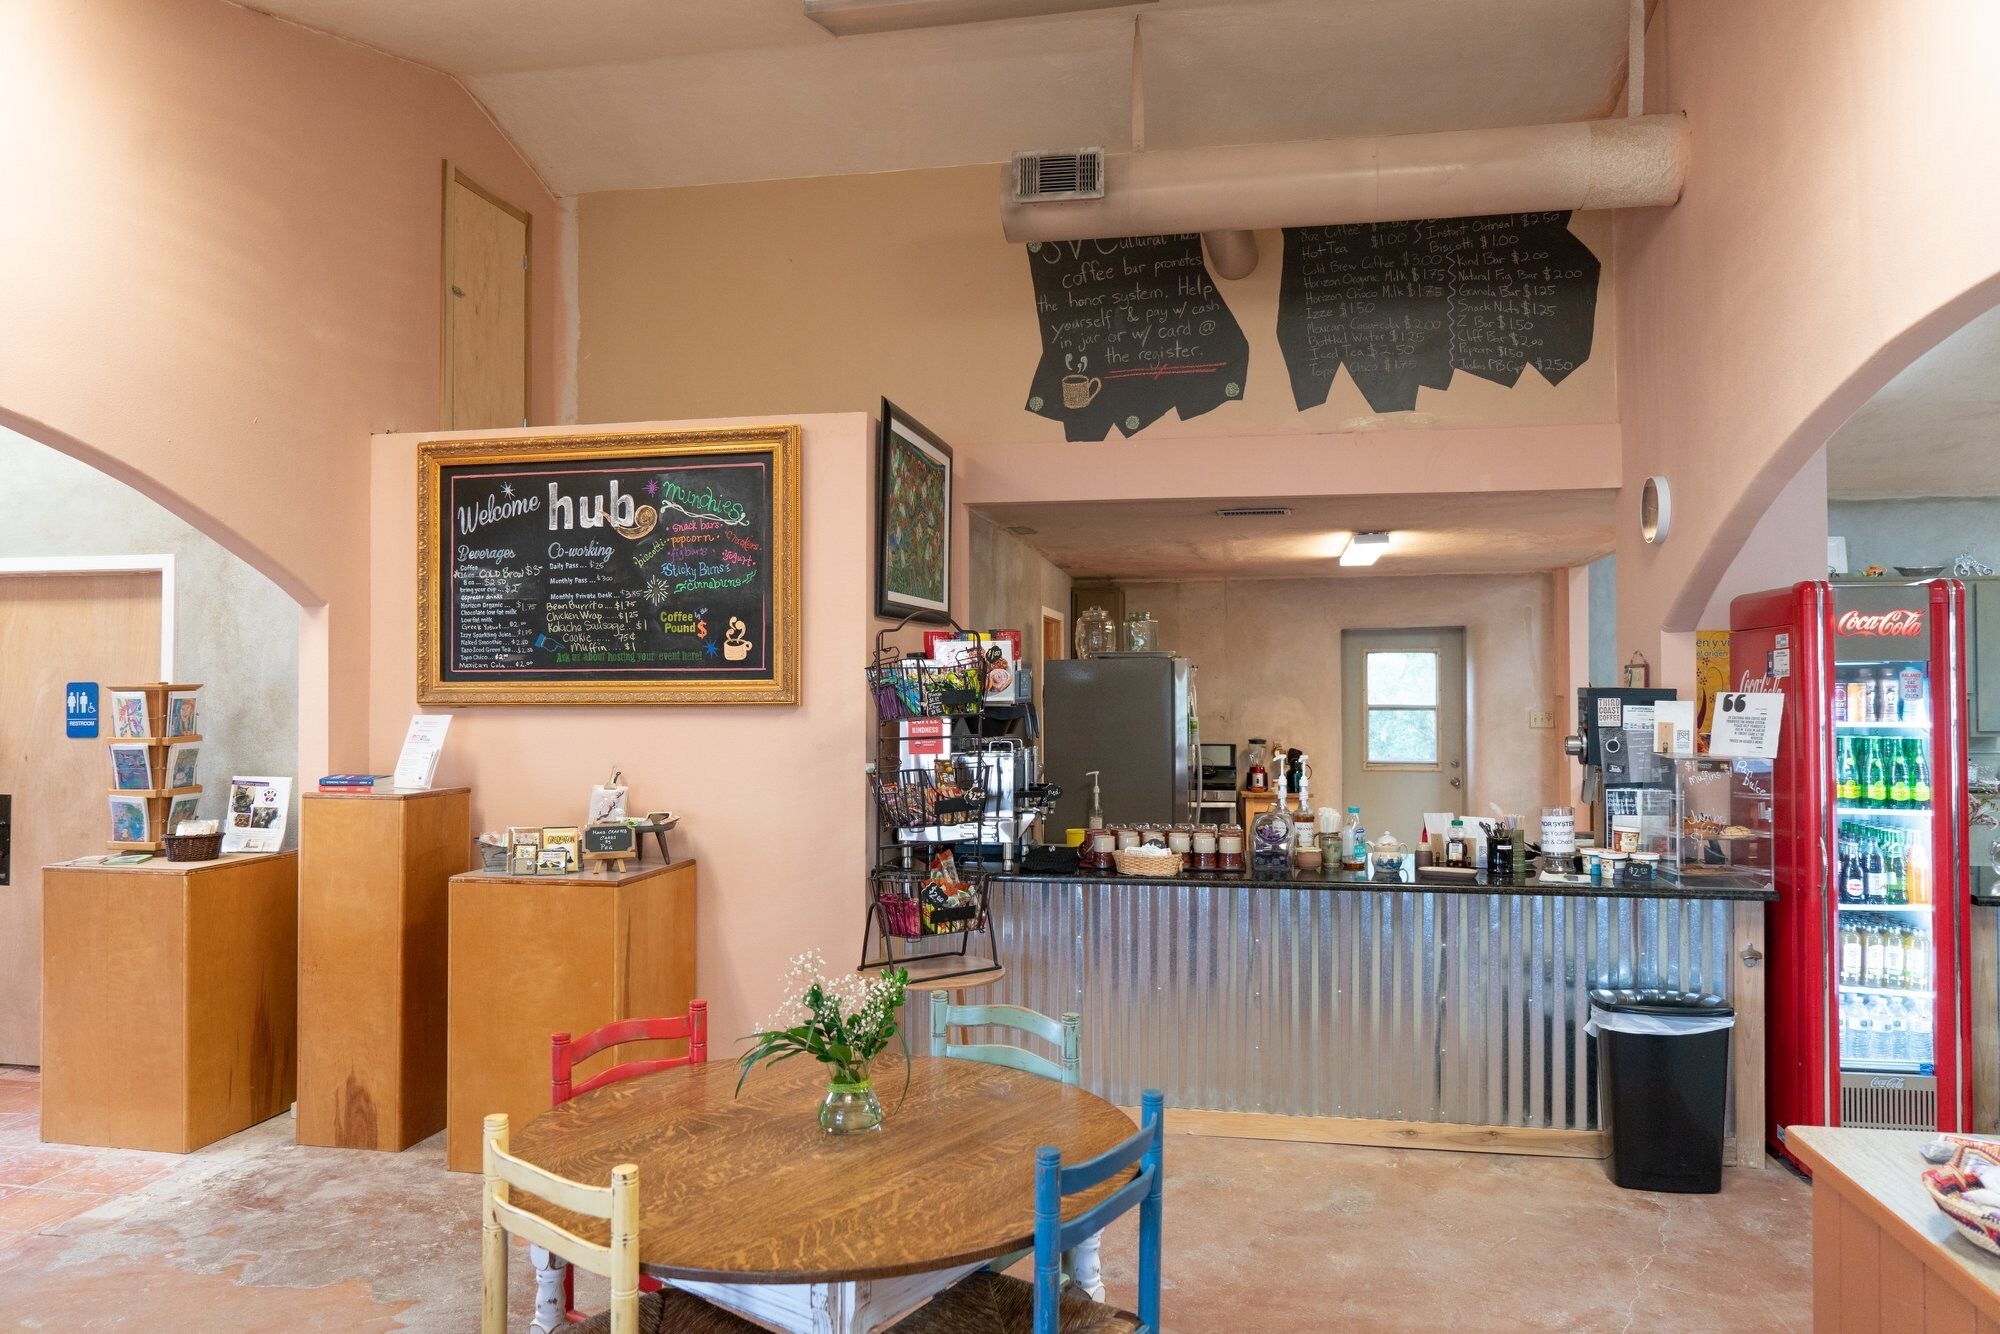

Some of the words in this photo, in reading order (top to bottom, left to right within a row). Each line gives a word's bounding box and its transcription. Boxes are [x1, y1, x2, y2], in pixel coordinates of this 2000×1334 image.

[1426, 223, 1468, 240] Instant
[1472, 214, 1514, 232] Oatmeal
[1302, 244, 1325, 260] Hot
[1325, 241, 1348, 254] Tea
[1371, 233, 1408, 248] $1.00
[1430, 237, 1474, 253] Biscotti
[1479, 235, 1520, 249] $1.00
[1303, 262, 1325, 276] Cold
[1330, 260, 1357, 272] Brew
[1362, 255, 1395, 270] Coffee
[1457, 254, 1480, 267] Kind
[1483, 252, 1505, 265] Bar
[1062, 260, 1114, 288] coffee
[1123, 256, 1146, 276] bar
[1154, 250, 1203, 276] promotes
[1304, 277, 1341, 289] Horizon
[1458, 269, 1491, 281] Natural
[1495, 268, 1513, 286] Fig
[1517, 269, 1538, 280] Bar
[1037, 295, 1058, 313] the
[1069, 291, 1106, 308] honor
[1112, 282, 1169, 309] system.
[1178, 275, 1213, 299] Help
[1347, 288, 1378, 299] Choco
[1458, 284, 1497, 296] Granola
[1499, 285, 1520, 298] Bar
[1305, 307, 1334, 319] Izze
[1458, 299, 1491, 313] Snack
[1494, 301, 1520, 314] Nuts
[1052, 308, 1112, 344] yourself
[1127, 306, 1139, 322] &
[1146, 308, 1168, 323] pay
[1173, 302, 1187, 318] w/
[1192, 302, 1220, 314] cash
[1456, 315, 1467, 327] Z
[1474, 315, 1495, 328] Bar
[1060, 336, 1072, 349] in
[1078, 333, 1101, 352] jar
[1108, 331, 1126, 343] or
[1132, 324, 1152, 347] w/
[1158, 320, 1191, 339] card
[1199, 320, 1216, 336] @
[1353, 331, 1384, 342] Water
[1104, 346, 1129, 363] the
[1138, 340, 1204, 369] register.
[1308, 347, 1338, 360] Iced
[1344, 344, 1364, 357] Tea
[548, 480, 635, 531] hub
[663, 481, 744, 521] Munchies
[457, 493, 541, 536] Welcome
[672, 523, 697, 532] snack
[701, 520, 720, 529] bars
[670, 534, 714, 547] popcorn
[457, 544, 516, 565] Beverages
[548, 539, 615, 562] Co-working
[633, 539, 665, 568] biscotti
[670, 548, 684, 562] fig
[549, 562, 564, 570] Daily
[663, 562, 697, 582] Sticky
[699, 562, 724, 577] Buns
[550, 577, 574, 585] Monthly
[482, 602, 503, 610] Organic
[546, 602, 568, 611] Bean
[569, 600, 603, 610] Burrito
[546, 612, 579, 622] Chicken
[580, 611, 602, 623] Wrap
[660, 611, 693, 622] Coffee
[1838, 608, 1924, 638] Coca-Cola
[461, 623, 482, 631] Greek
[547, 623, 582, 633] Kolache
[584, 620, 625, 636] Sausage
[665, 622, 696, 633] Pound
[562, 633, 592, 642] Cookie
[1712, 639, 1719, 649] y
[570, 642, 607, 653] Muffin
[624, 642, 636, 652] $1
[557, 653, 569, 662] Ask
[608, 652, 635, 662] hosting
[637, 653, 654, 662] your
[660, 652, 680, 660] event
[1704, 651, 1728, 659] origen
[1599, 714, 1620, 722] COFFEE
[1742, 776, 1767, 795] Dulce
[1870, 1076, 1905, 1090] Coca-Cola
